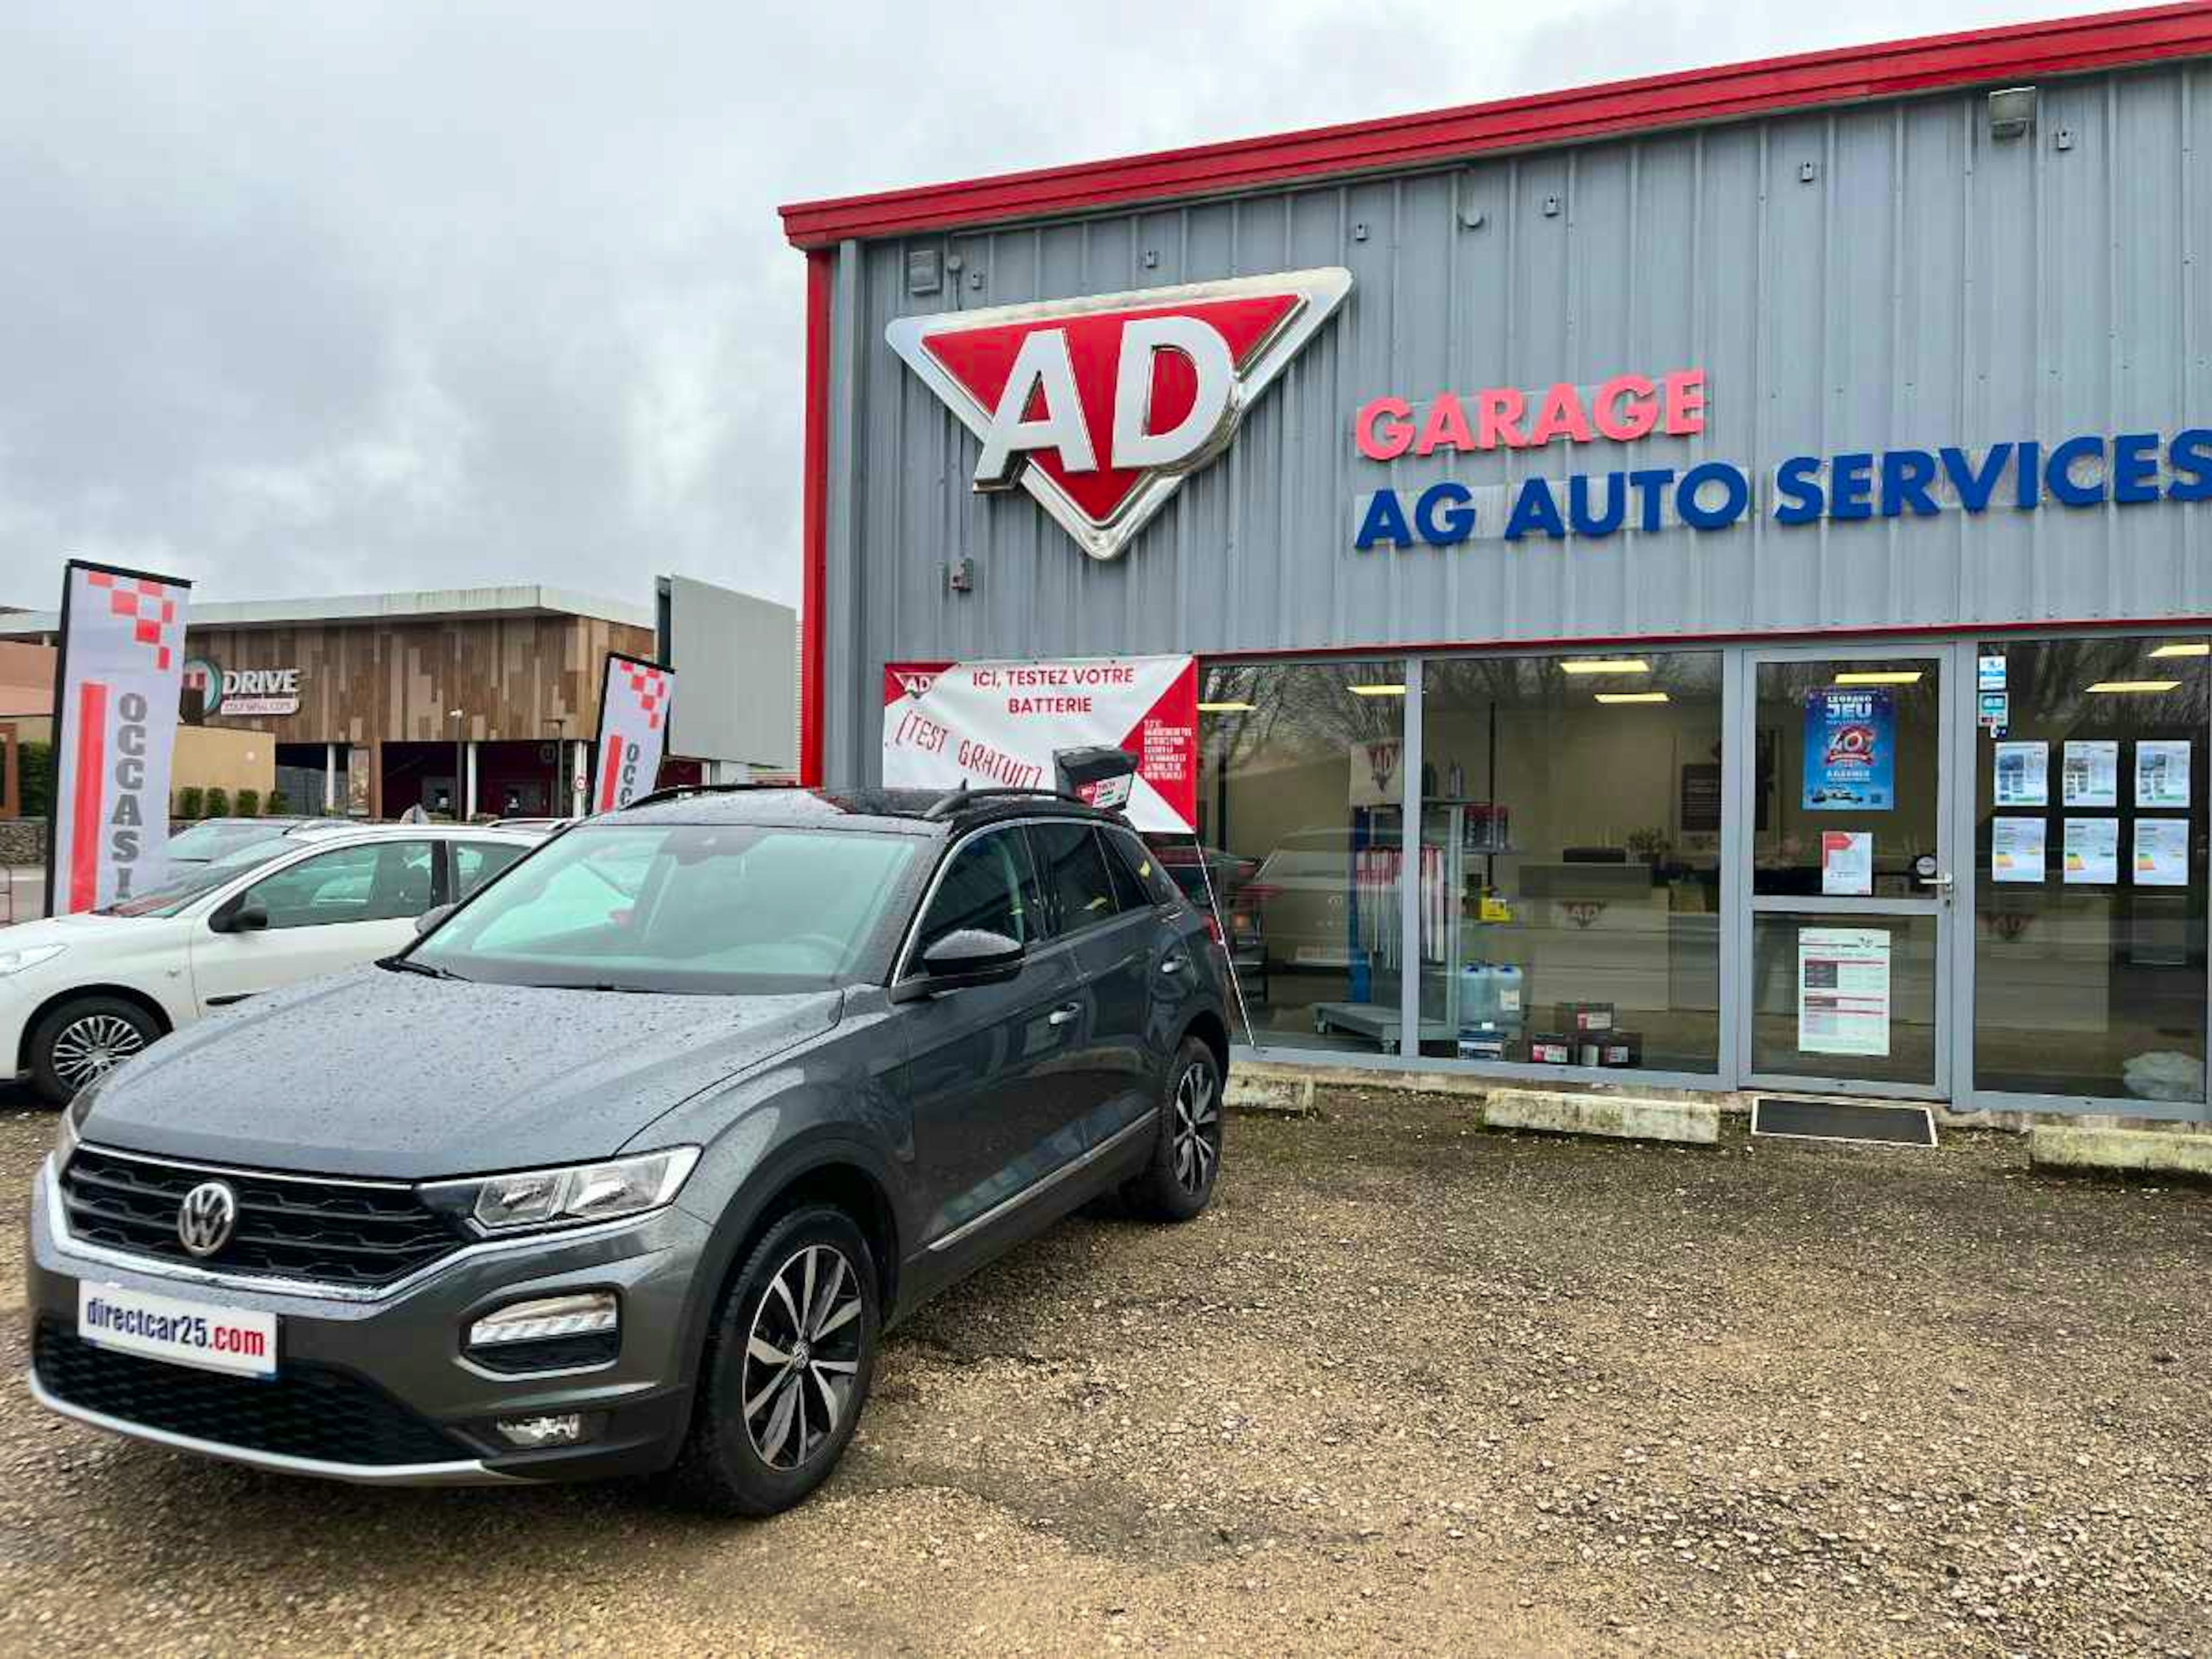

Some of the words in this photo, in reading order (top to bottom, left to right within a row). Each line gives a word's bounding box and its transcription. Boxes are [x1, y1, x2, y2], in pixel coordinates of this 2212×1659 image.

[972, 315, 1238, 487] AD
[1355, 370, 1705, 461] GARAGE
[1355, 482, 1476, 549] AG
[1504, 463, 1748, 540] AUTO
[1774, 429, 2212, 525] SERVICES
[222, 668, 301, 695] DRIVE
[906, 676, 931, 692] AD
[973, 670, 1001, 688] ICI,
[1007, 669, 1068, 685] TESTEZ
[1073, 667, 1134, 684] VOTRE
[1009, 697, 1092, 714] BATTERIE
[1826, 703, 1873, 718] JEU
[88, 1297, 266, 1357] directcar25.com
